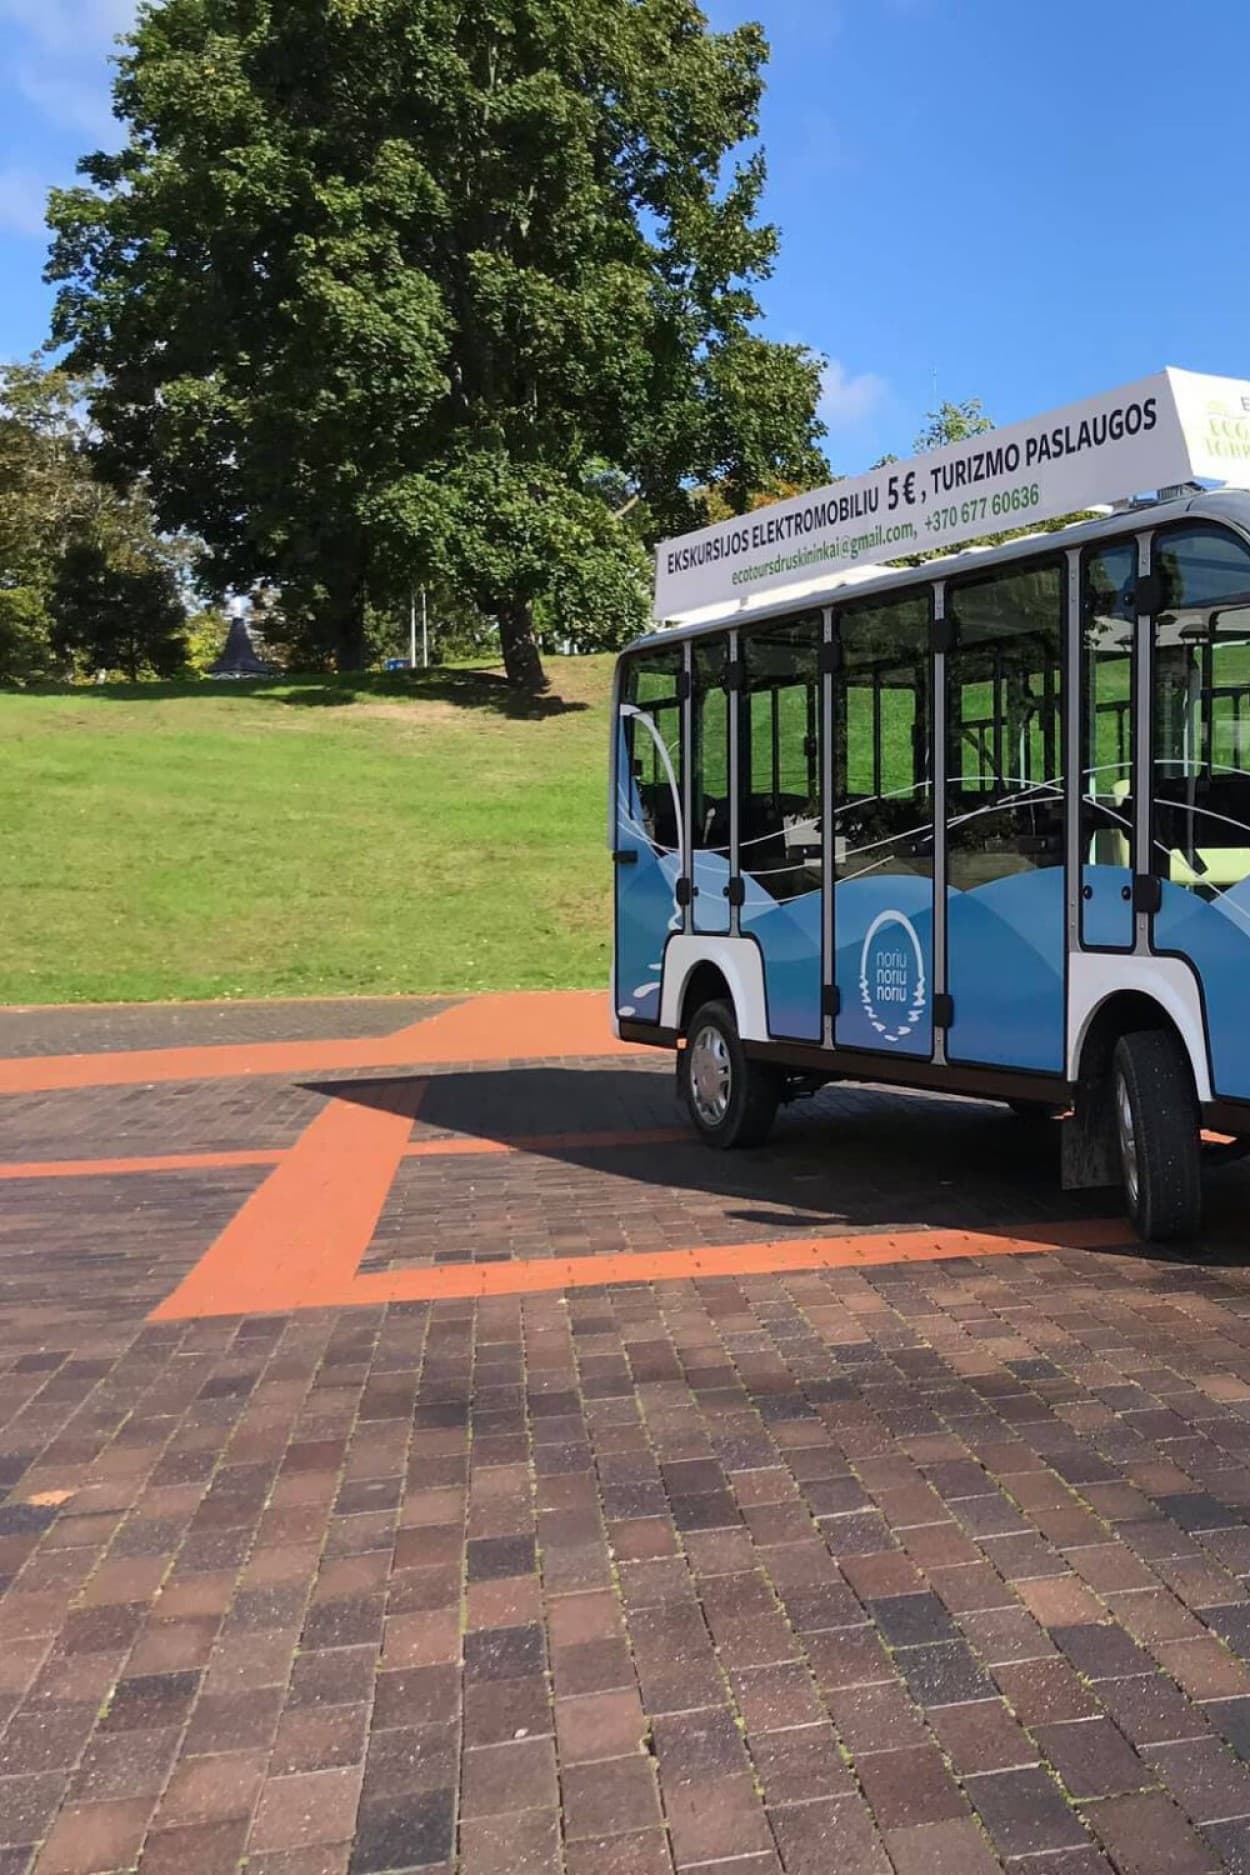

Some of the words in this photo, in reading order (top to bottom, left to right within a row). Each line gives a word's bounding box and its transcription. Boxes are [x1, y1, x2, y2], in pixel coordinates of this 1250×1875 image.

[667, 529, 750, 575] EKSKURSIJOS
[752, 486, 879, 548] ELEKTROMOBILIU
[930, 443, 1020, 495] TURIZMO
[1025, 398, 1157, 467] PASLAUGOS
[924, 504, 958, 532] +370
[960, 497, 988, 524] 677
[991, 483, 1040, 515] 60636
[876, 948, 907, 968] noriu
[876, 967, 907, 985] noriu
[876, 984, 907, 1001] noriu
